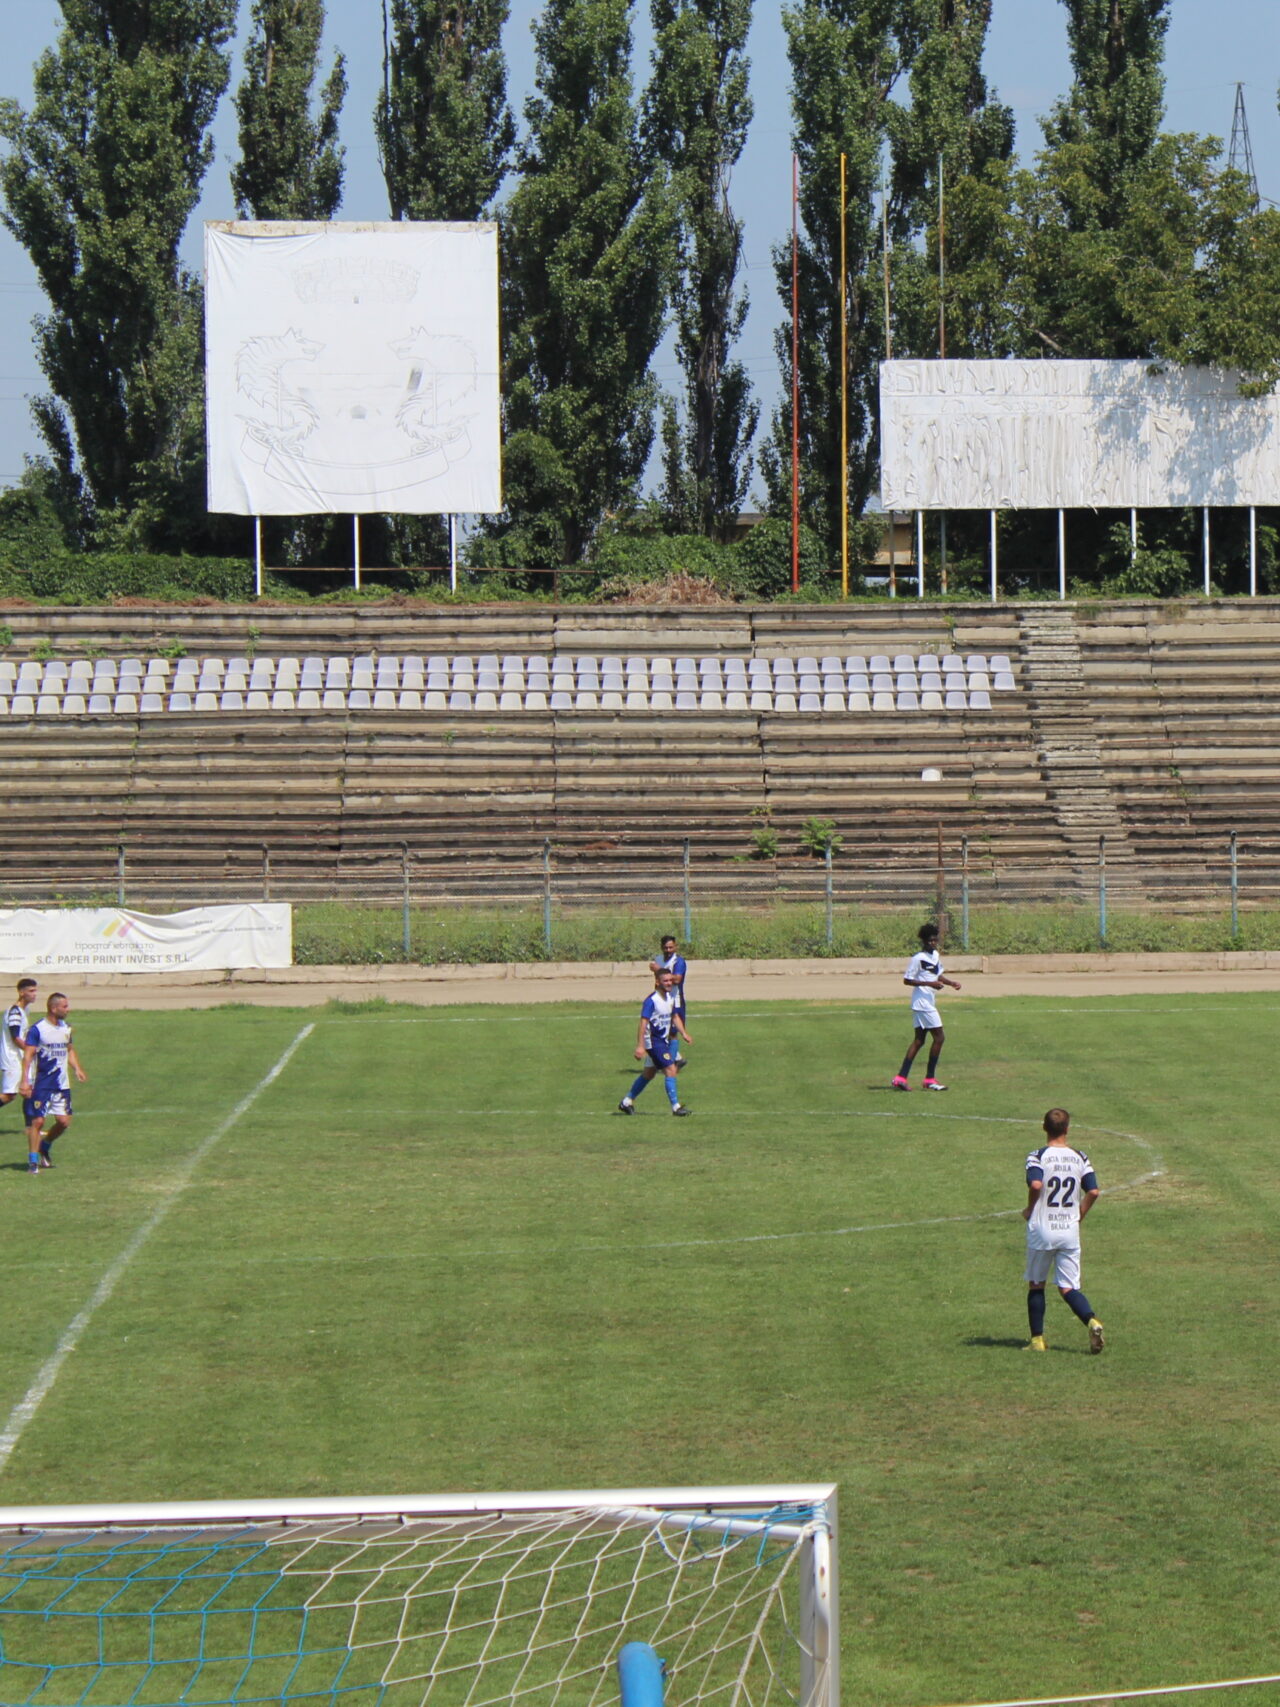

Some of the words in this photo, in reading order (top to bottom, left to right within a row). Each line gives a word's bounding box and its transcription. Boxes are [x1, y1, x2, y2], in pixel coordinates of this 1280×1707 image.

[57, 955, 90, 964] PAPER
[93, 955, 123, 964] PRINT
[126, 954, 162, 964] INVEST
[1047, 1176, 1076, 1208] 22
